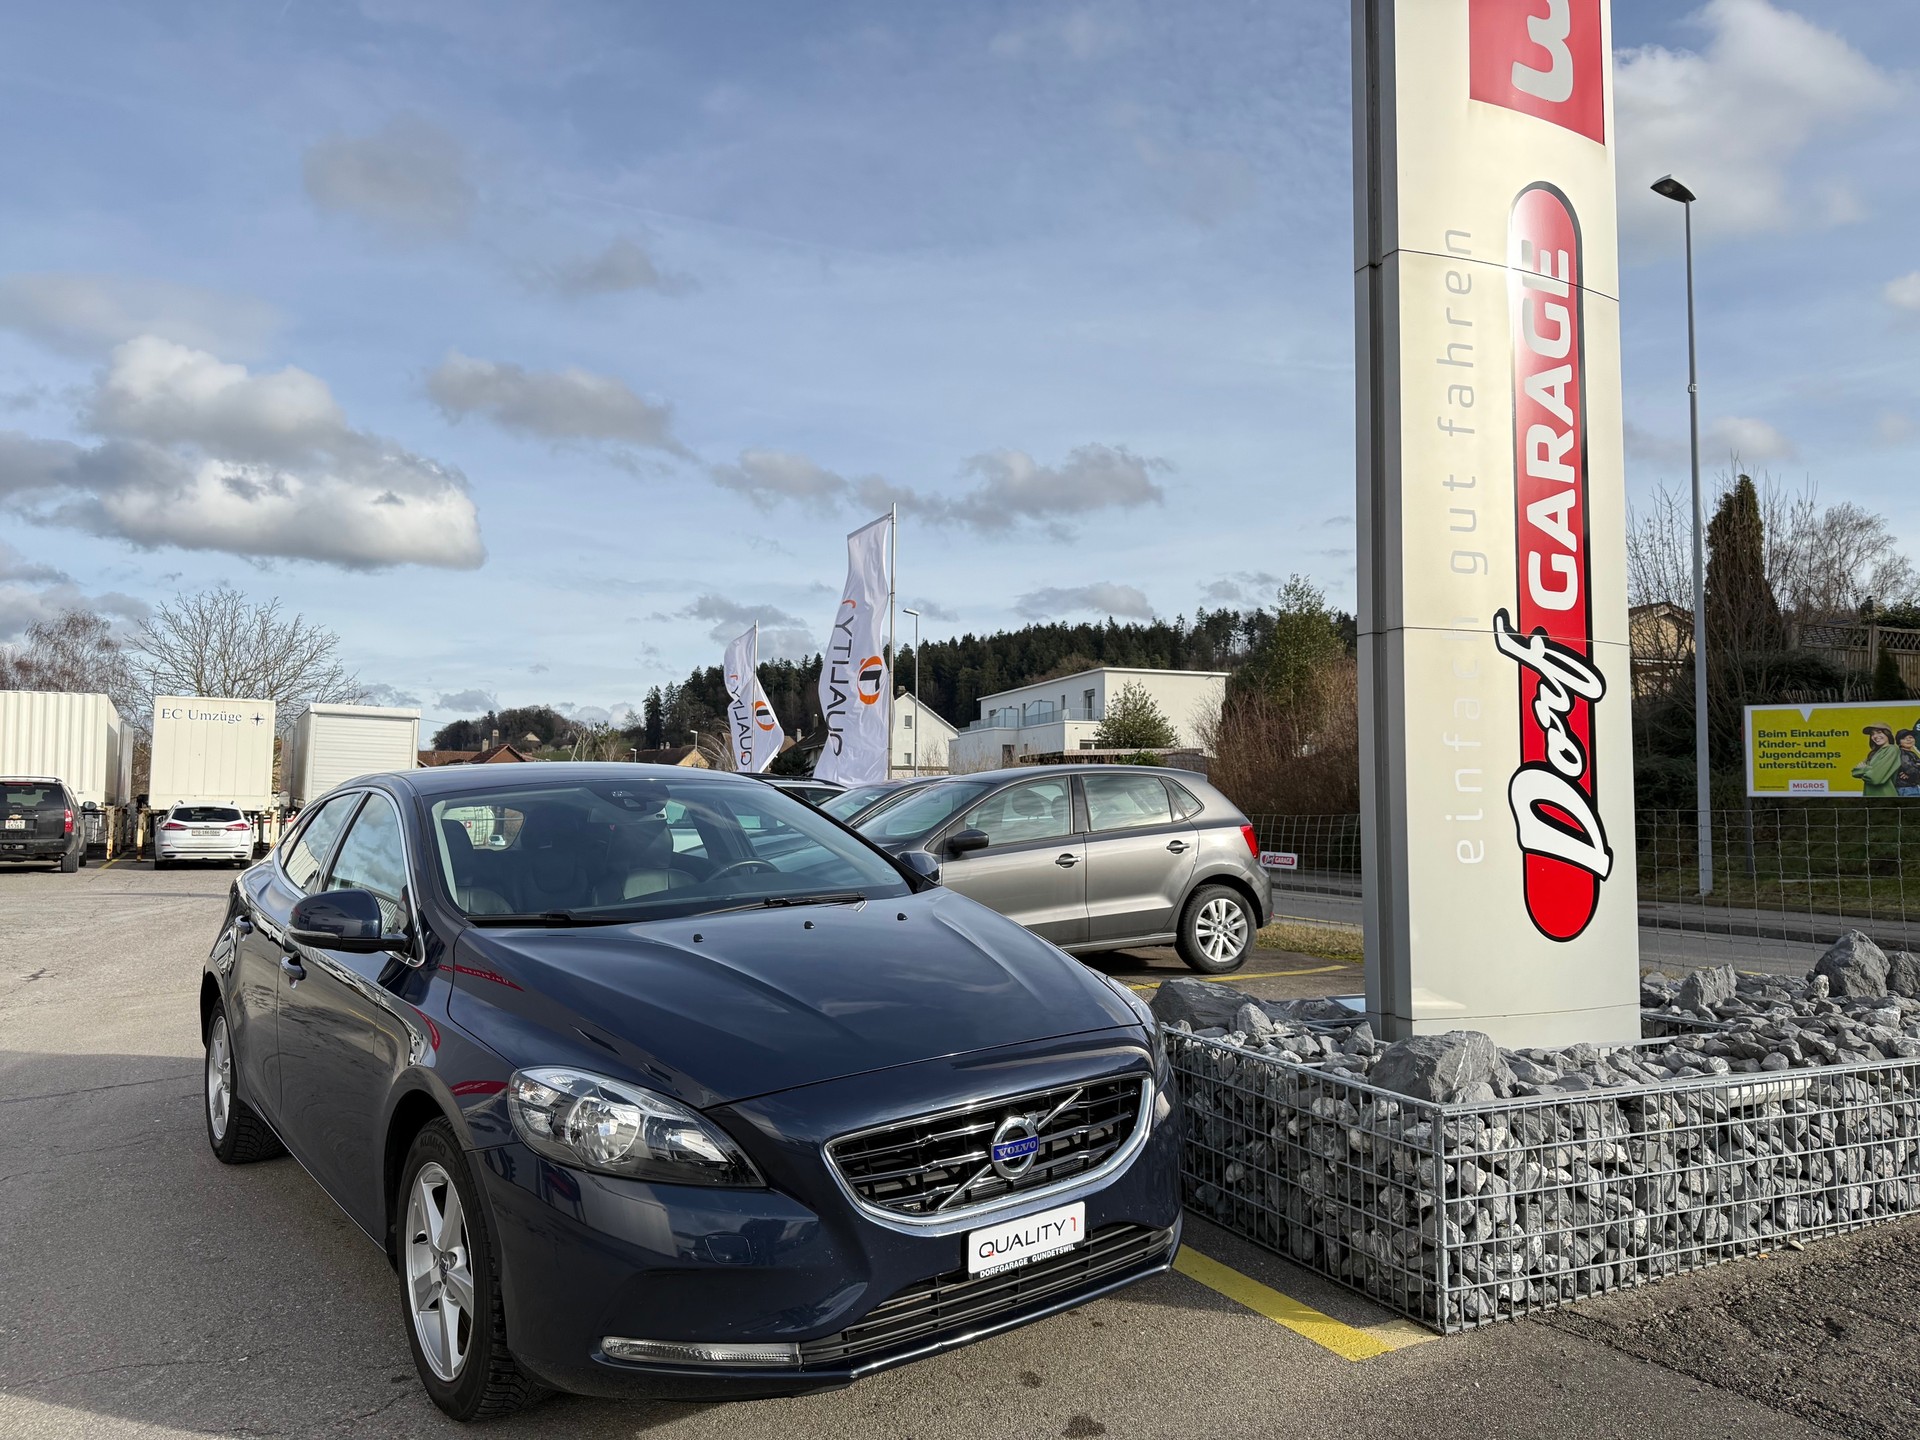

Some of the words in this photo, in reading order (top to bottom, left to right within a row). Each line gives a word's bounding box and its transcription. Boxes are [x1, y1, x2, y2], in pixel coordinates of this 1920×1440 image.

[1436, 229, 1476, 436] fahren
[1522, 238, 1579, 611] GARAGE
[1442, 474, 1488, 575] gut
[162, 708, 183, 720] EC
[188, 710, 242, 725] Umzüge
[1443, 617, 1485, 864] einfach
[1495, 611, 1611, 880] Dorf
[1758, 730, 1787, 738] Beim
[1790, 729, 1849, 738] Einkaufen
[1758, 740, 1801, 748] Kinder-
[1804, 740, 1826, 748] und
[1758, 751, 1841, 760] Jugendcamps
[1759, 761, 1837, 769] unterstützen.
[420, 1135, 446, 1157] KUMHO
[997, 1141, 1036, 1157] VOLVO
[979, 1219, 1066, 1258] QUALITY
[1070, 1217, 1077, 1231] 1
[980, 1258, 1028, 1278] DORFGARAGE
[1032, 1244, 1075, 1262] GUNDETSWIL
